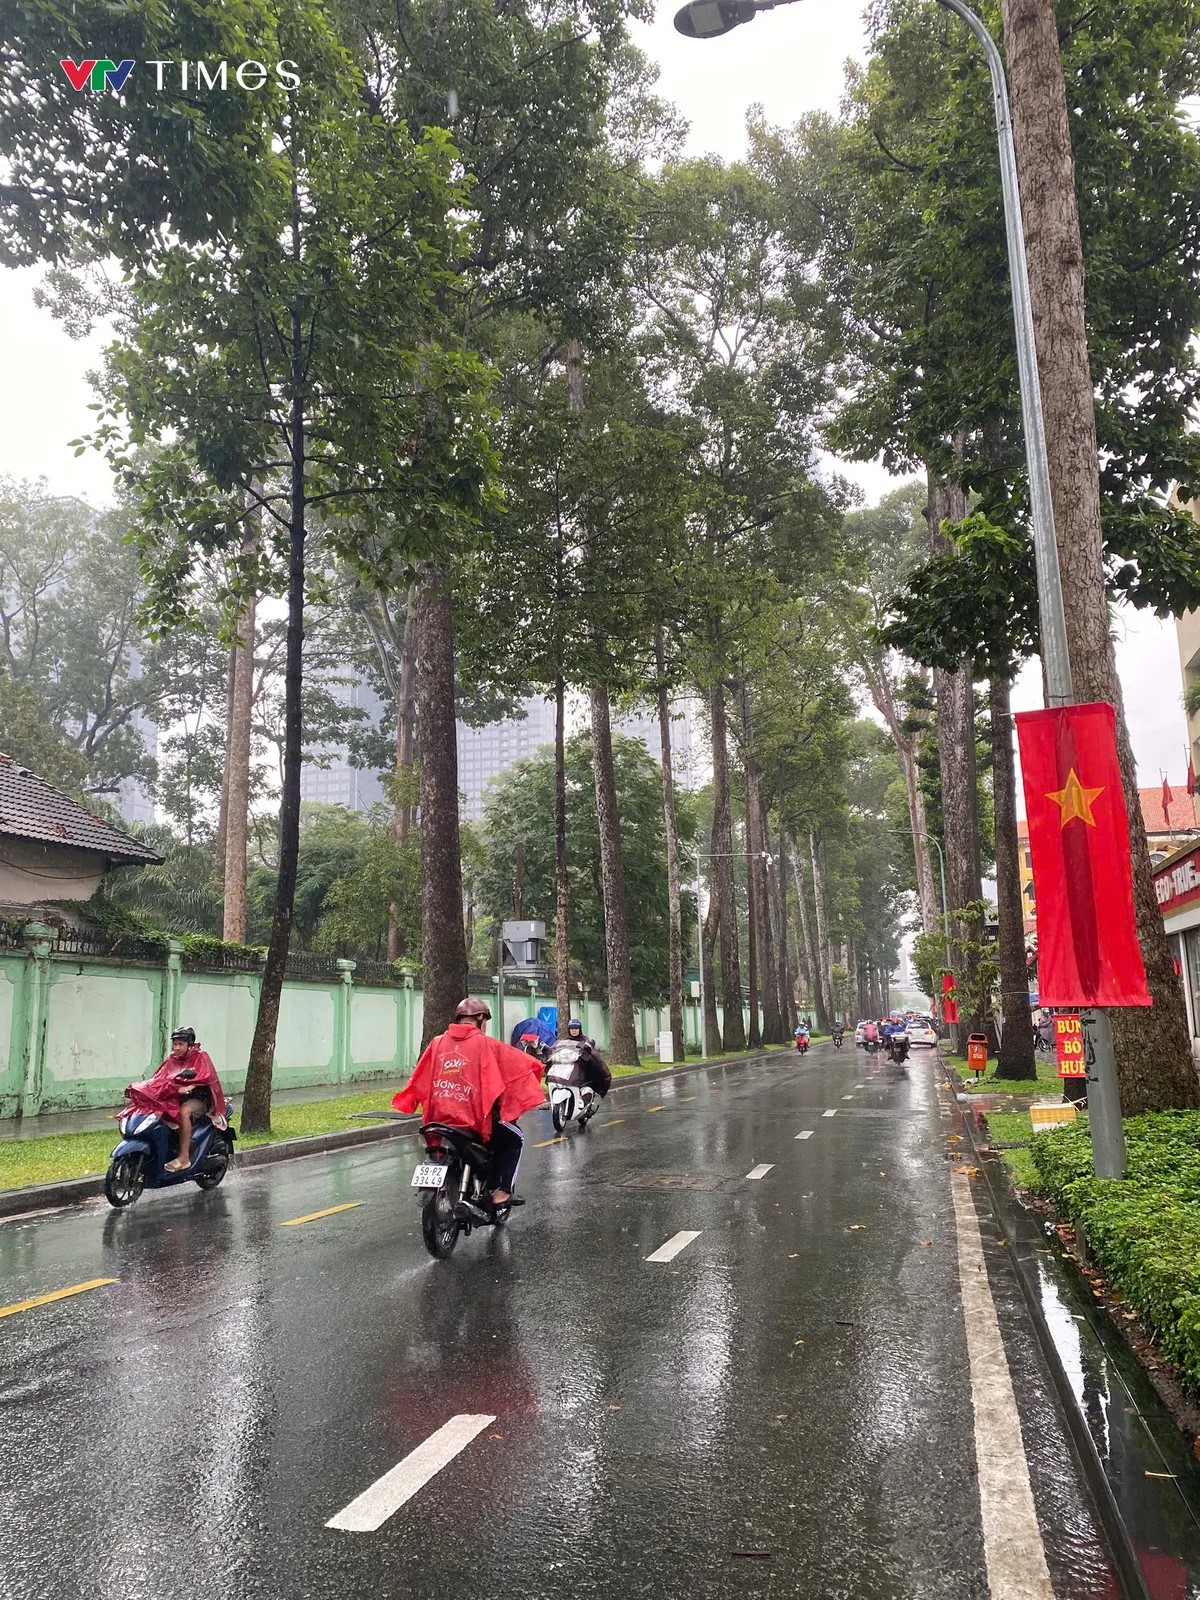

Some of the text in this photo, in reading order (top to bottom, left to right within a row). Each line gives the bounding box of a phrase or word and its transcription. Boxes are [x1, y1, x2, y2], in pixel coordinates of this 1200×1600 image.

[1155, 860, 1200, 904] ECO-TRUE
[1064, 1037, 1082, 1054] BÒ
[420, 1166, 442, 1176] 59-P2
